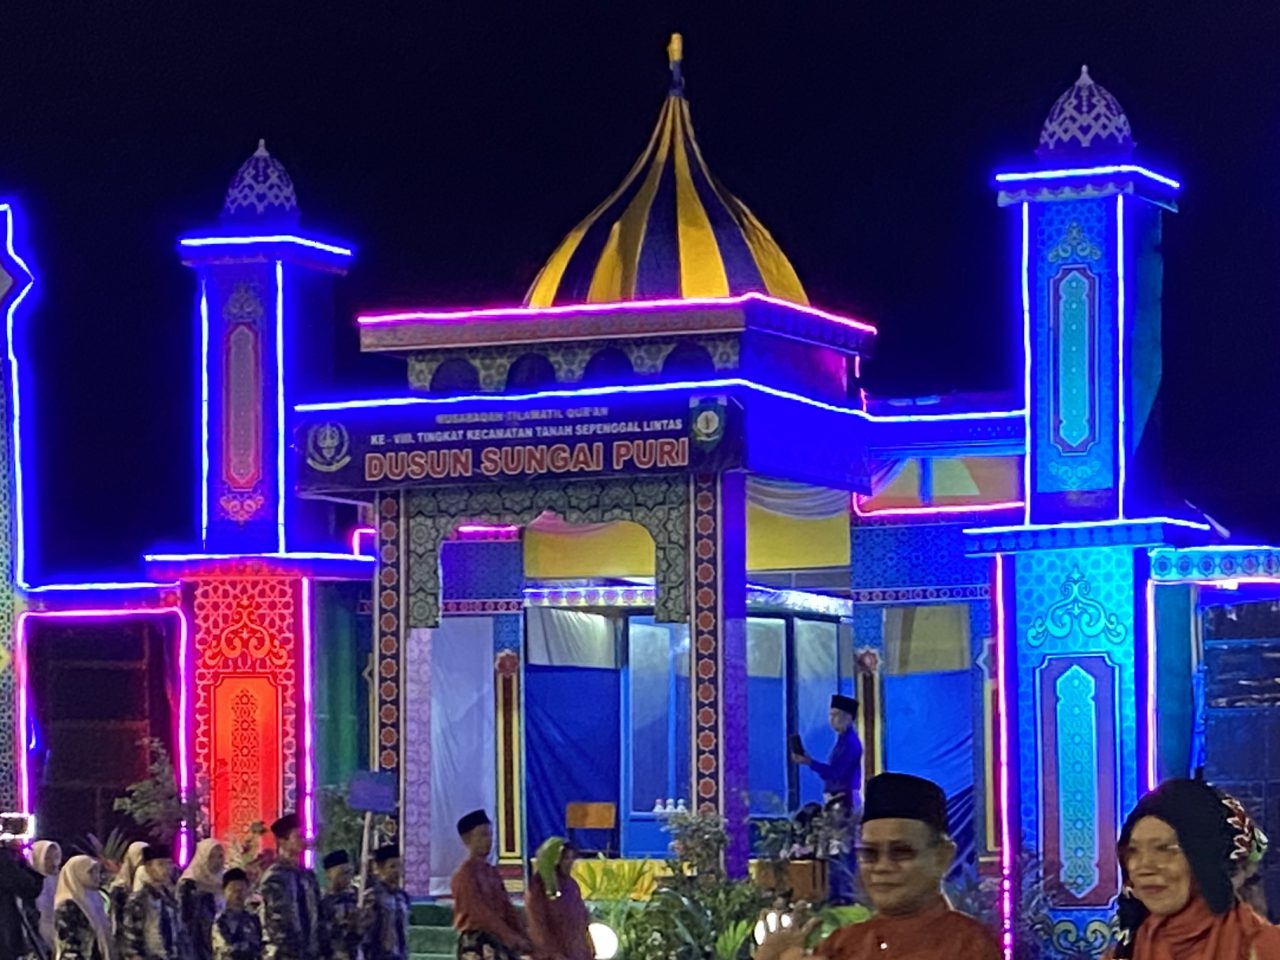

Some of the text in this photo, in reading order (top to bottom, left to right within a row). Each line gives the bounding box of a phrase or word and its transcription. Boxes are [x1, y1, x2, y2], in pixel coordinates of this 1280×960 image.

[371, 434, 385, 445] KE
[417, 430, 464, 443] TINGKAT
[466, 428, 533, 440] KECAMATAN
[536, 426, 573, 437] TANAH
[574, 422, 641, 436] SEPENGGAL
[643, 419, 683, 432] LINTAS
[365, 448, 473, 481] DUSUN
[480, 442, 604, 476] SUNGAI
[612, 437, 690, 471] PURI
